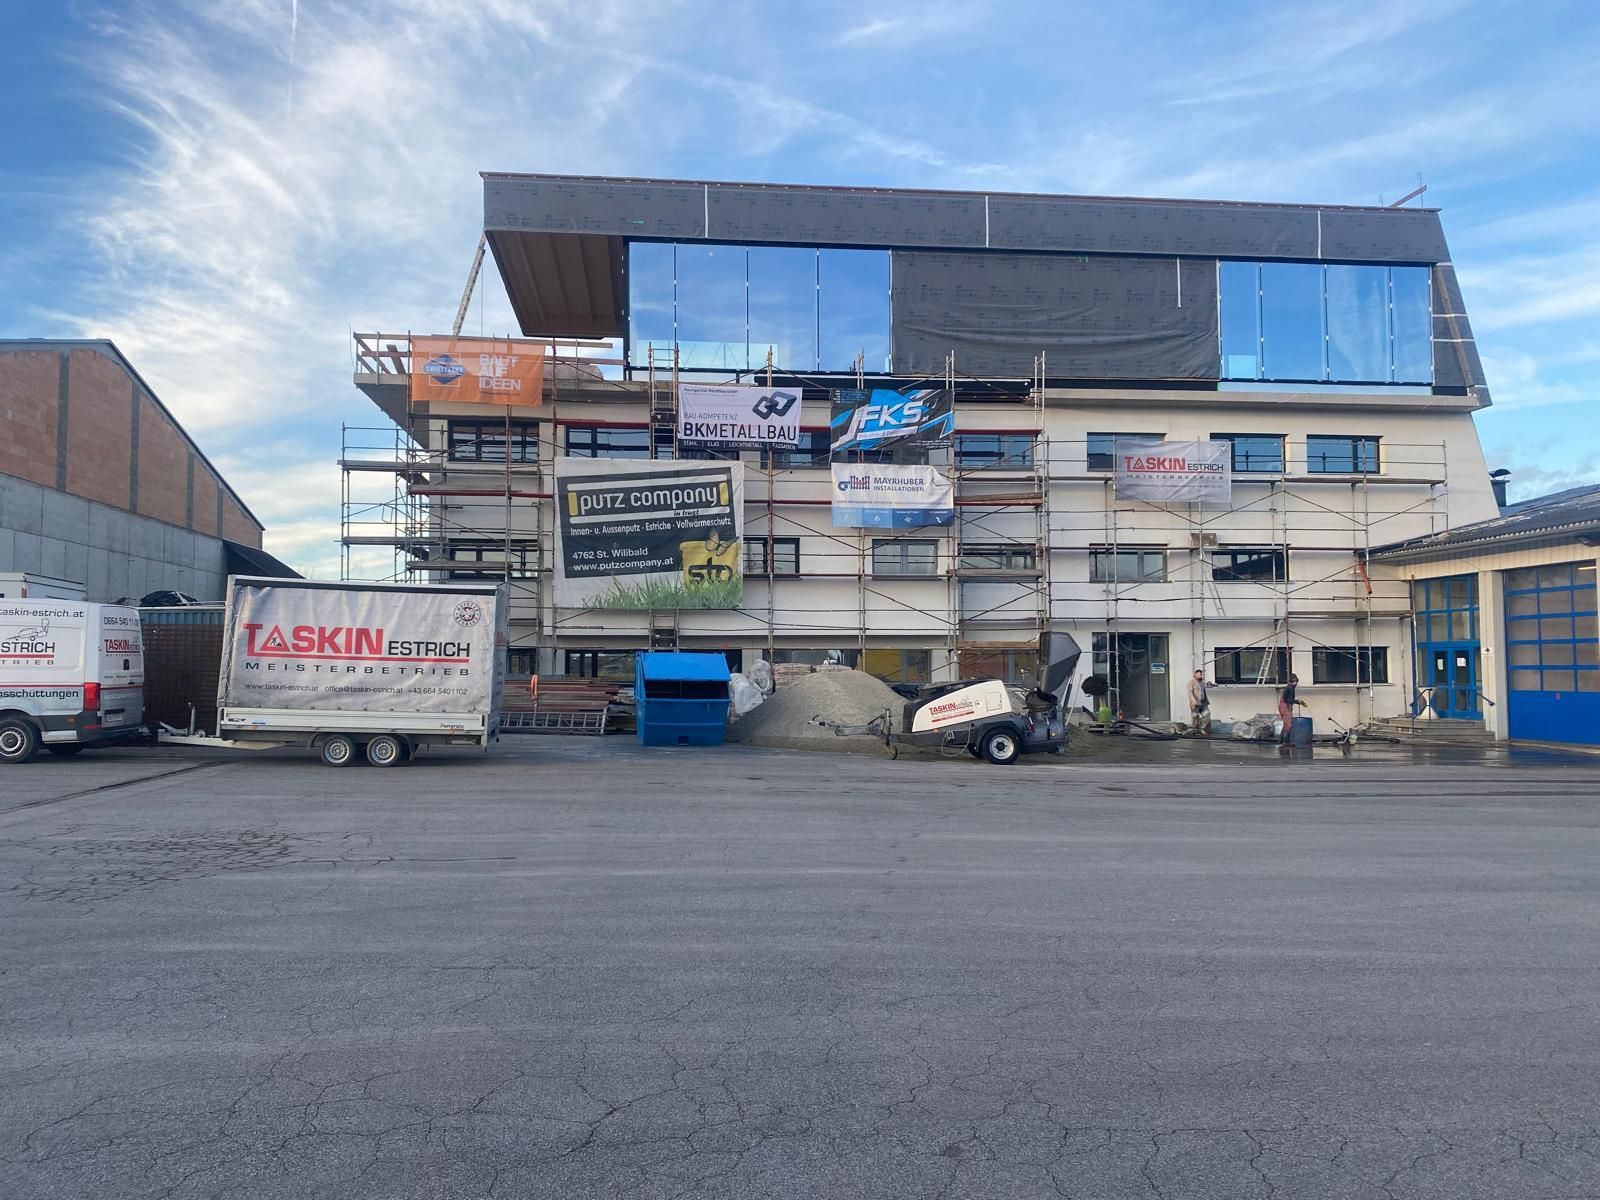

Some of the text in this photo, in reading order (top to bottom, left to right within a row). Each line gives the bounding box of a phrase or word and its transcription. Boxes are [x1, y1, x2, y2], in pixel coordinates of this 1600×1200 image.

[479, 377, 521, 391] IDEEN
[859, 400, 925, 430] FKS
[683, 421, 797, 441] BKMETALLBAU
[1124, 457, 1224, 474] TASKIN ESTRICH
[873, 477, 925, 486] MAYRHUBER
[630, 486, 717, 510] company
[570, 526, 593, 537] Innen-
[602, 522, 640, 535] Aussenputz
[645, 520, 672, 532] Estriche
[676, 516, 731, 530] Vollwärmeschutz
[572, 547, 648, 560] 4762 St. Willibald
[573, 556, 674, 572] www.putzcompany.at
[104, 639, 130, 653] TASKIN
[242, 623, 471, 657] TASKIN ESTRICH
[245, 662, 470, 675] MEISTERBETRIEB
[245, 683, 319, 692] www.taskin-estrich.at
[324, 685, 403, 695] office@taskin-estrich.at
[929, 702, 956, 716] TASKIN
